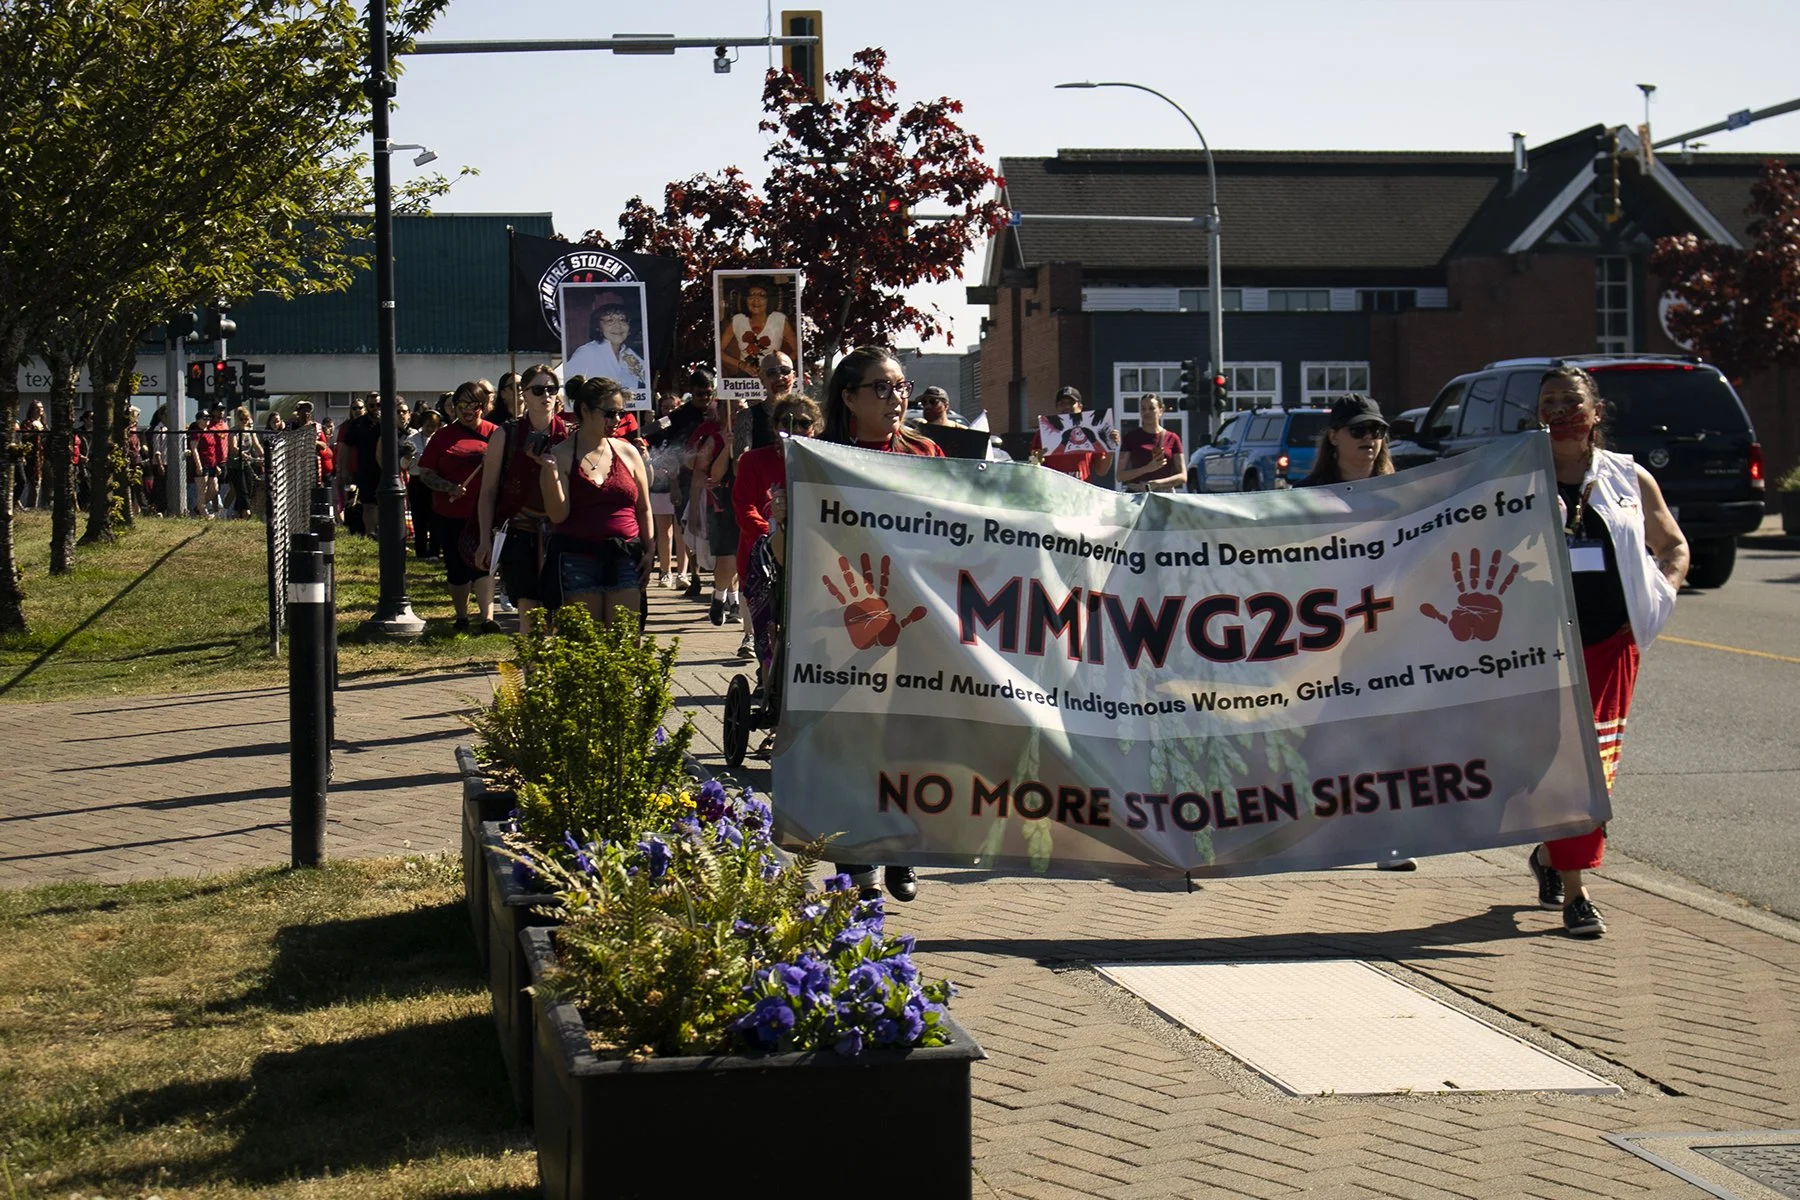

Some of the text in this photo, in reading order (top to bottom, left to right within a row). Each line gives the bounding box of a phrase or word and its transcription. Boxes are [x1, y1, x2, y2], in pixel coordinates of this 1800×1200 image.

[541, 260, 570, 297] MORE
[570, 255, 623, 276] STOLEN
[724, 380, 760, 390] Patricia
[820, 491, 1535, 574] Honouring, Remembering and Demanding Justice for
[956, 569, 1394, 670] MMIWG2S+
[793, 663, 887, 692] Missing
[895, 670, 943, 692] and
[950, 674, 1058, 707] Murdered
[1064, 691, 1186, 720] Indigenous
[1192, 691, 1290, 712] Women,
[1296, 676, 1361, 700] Girls,
[1368, 663, 1415, 692] and
[1419, 646, 1546, 685] Two-Spirit
[878, 758, 1494, 833] NO MORE STOLEN SISTERS
